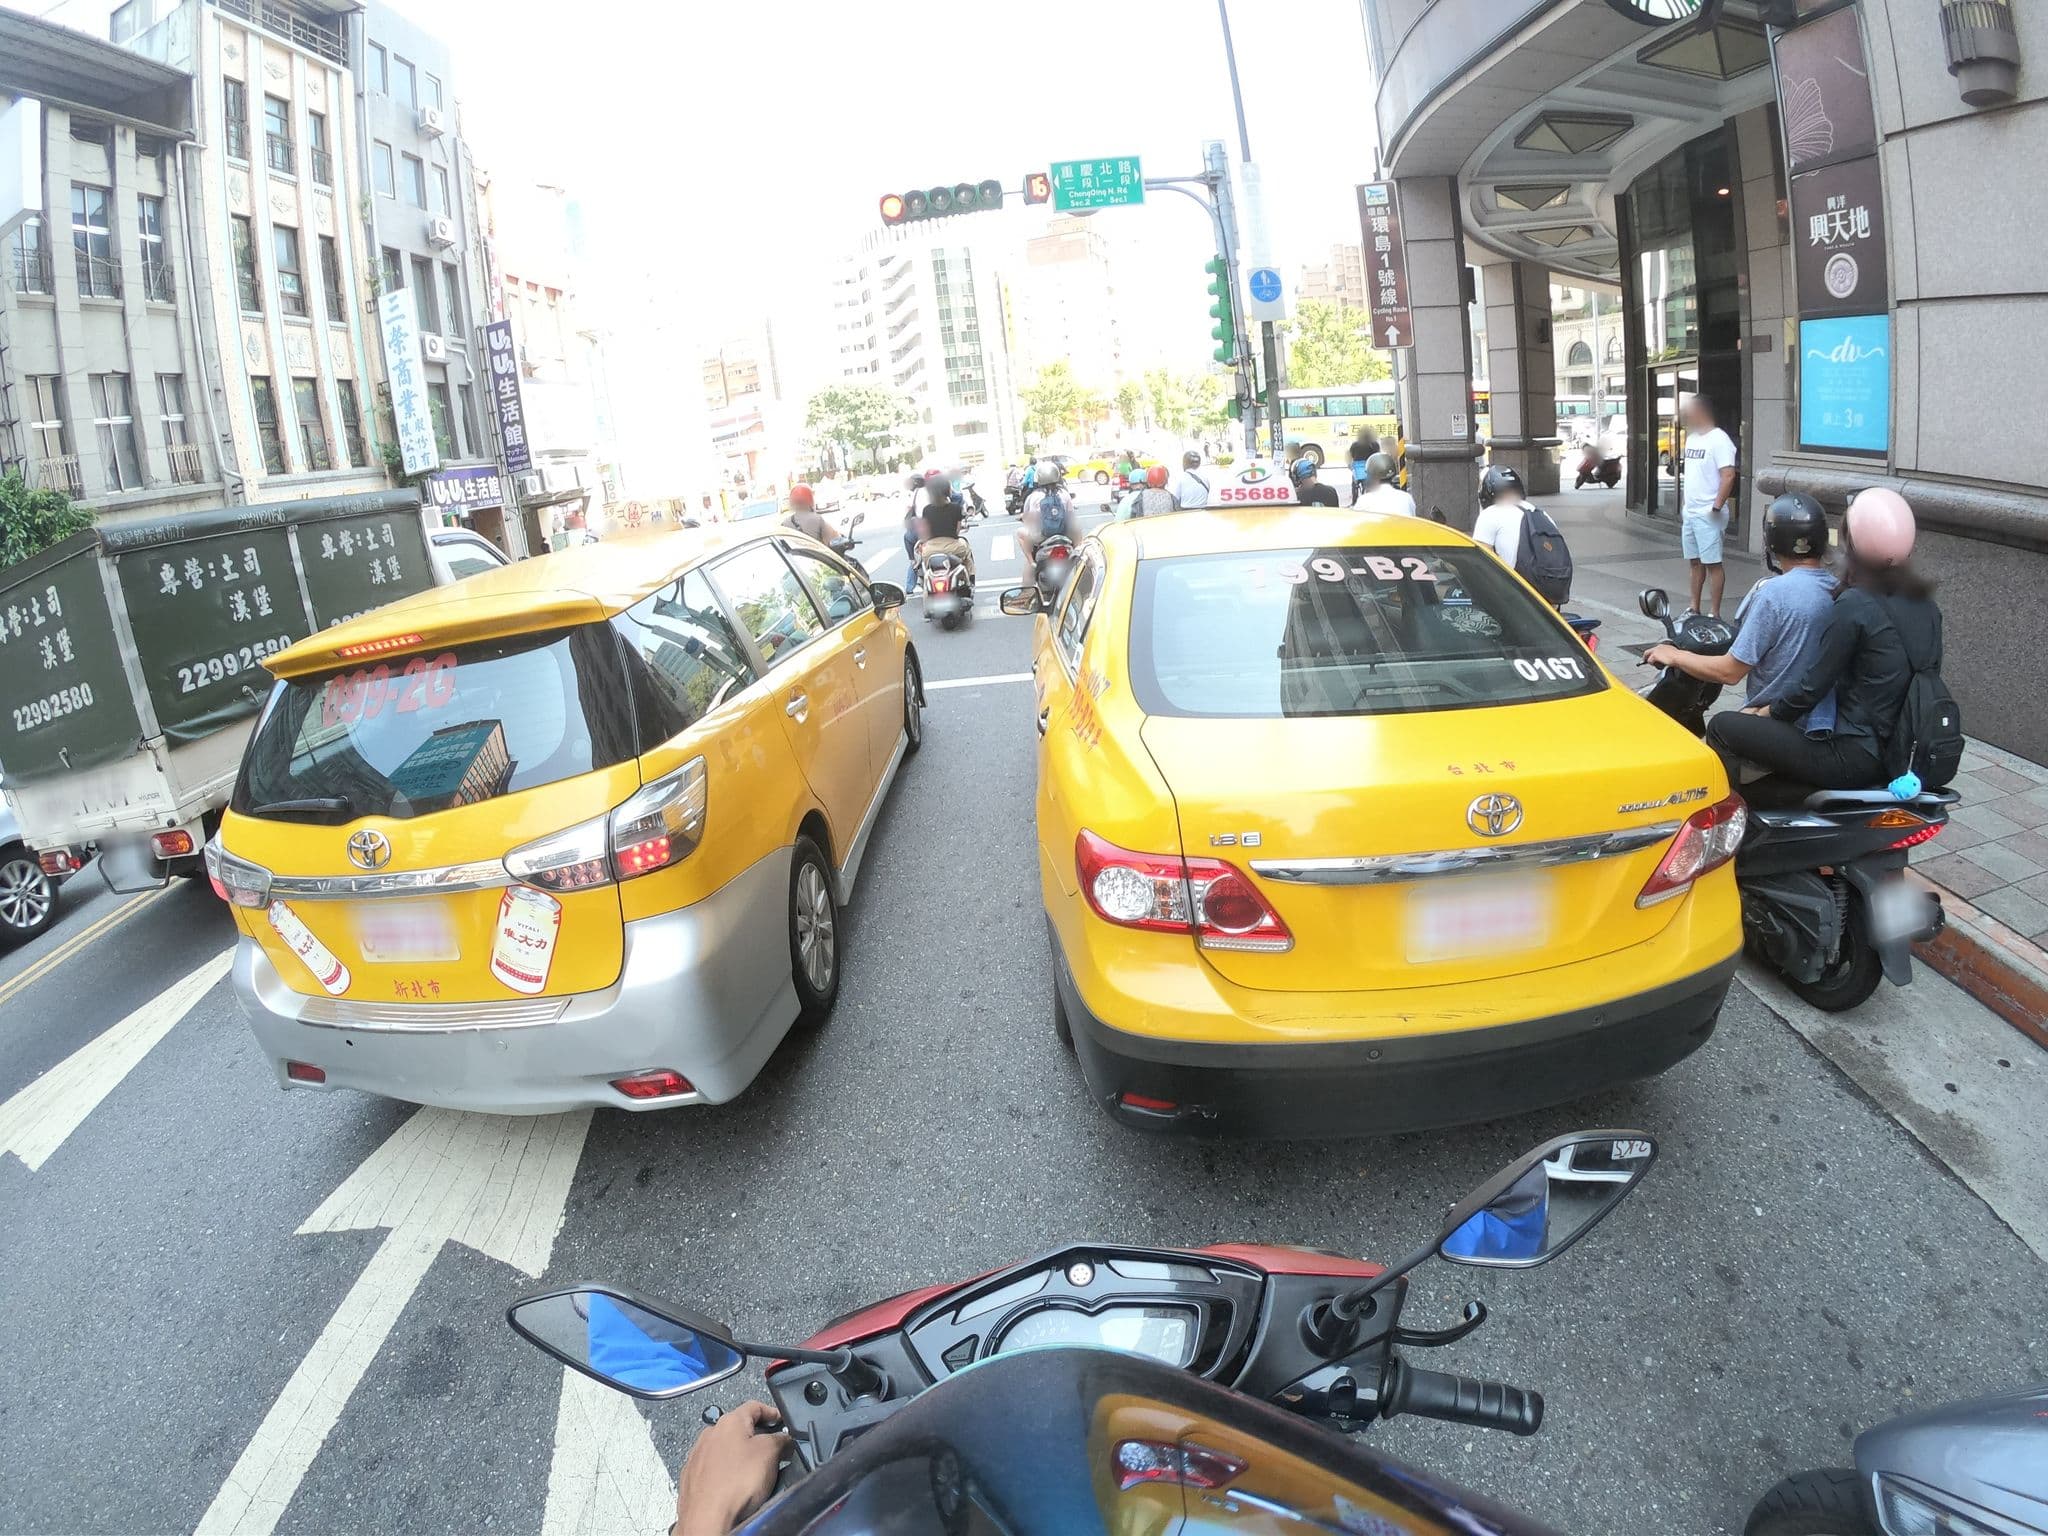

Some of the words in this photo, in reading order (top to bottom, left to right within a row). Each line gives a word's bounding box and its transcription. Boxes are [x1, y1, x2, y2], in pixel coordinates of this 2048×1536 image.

[1062, 161, 1131, 178] 重慶北路
[1068, 189, 1107, 199] ChongQing
[1809, 205, 1871, 247] 興天地
[1371, 216, 1398, 305] 環島1號線
[1350, 423, 1398, 437] 互美語
[1219, 486, 1290, 502] 55688
[369, 555, 402, 585] 漢堡
[228, 584, 273, 623] 漢堡
[39, 627, 75, 670] 漢堡
[177, 634, 292, 694] 22992580
[1514, 657, 1585, 682] 0167
[12, 682, 94, 732] 22992580
[1447, 760, 1516, 776] 台北市
[516, 921, 541, 934] VITALI
[392, 978, 441, 1000] 新北市
